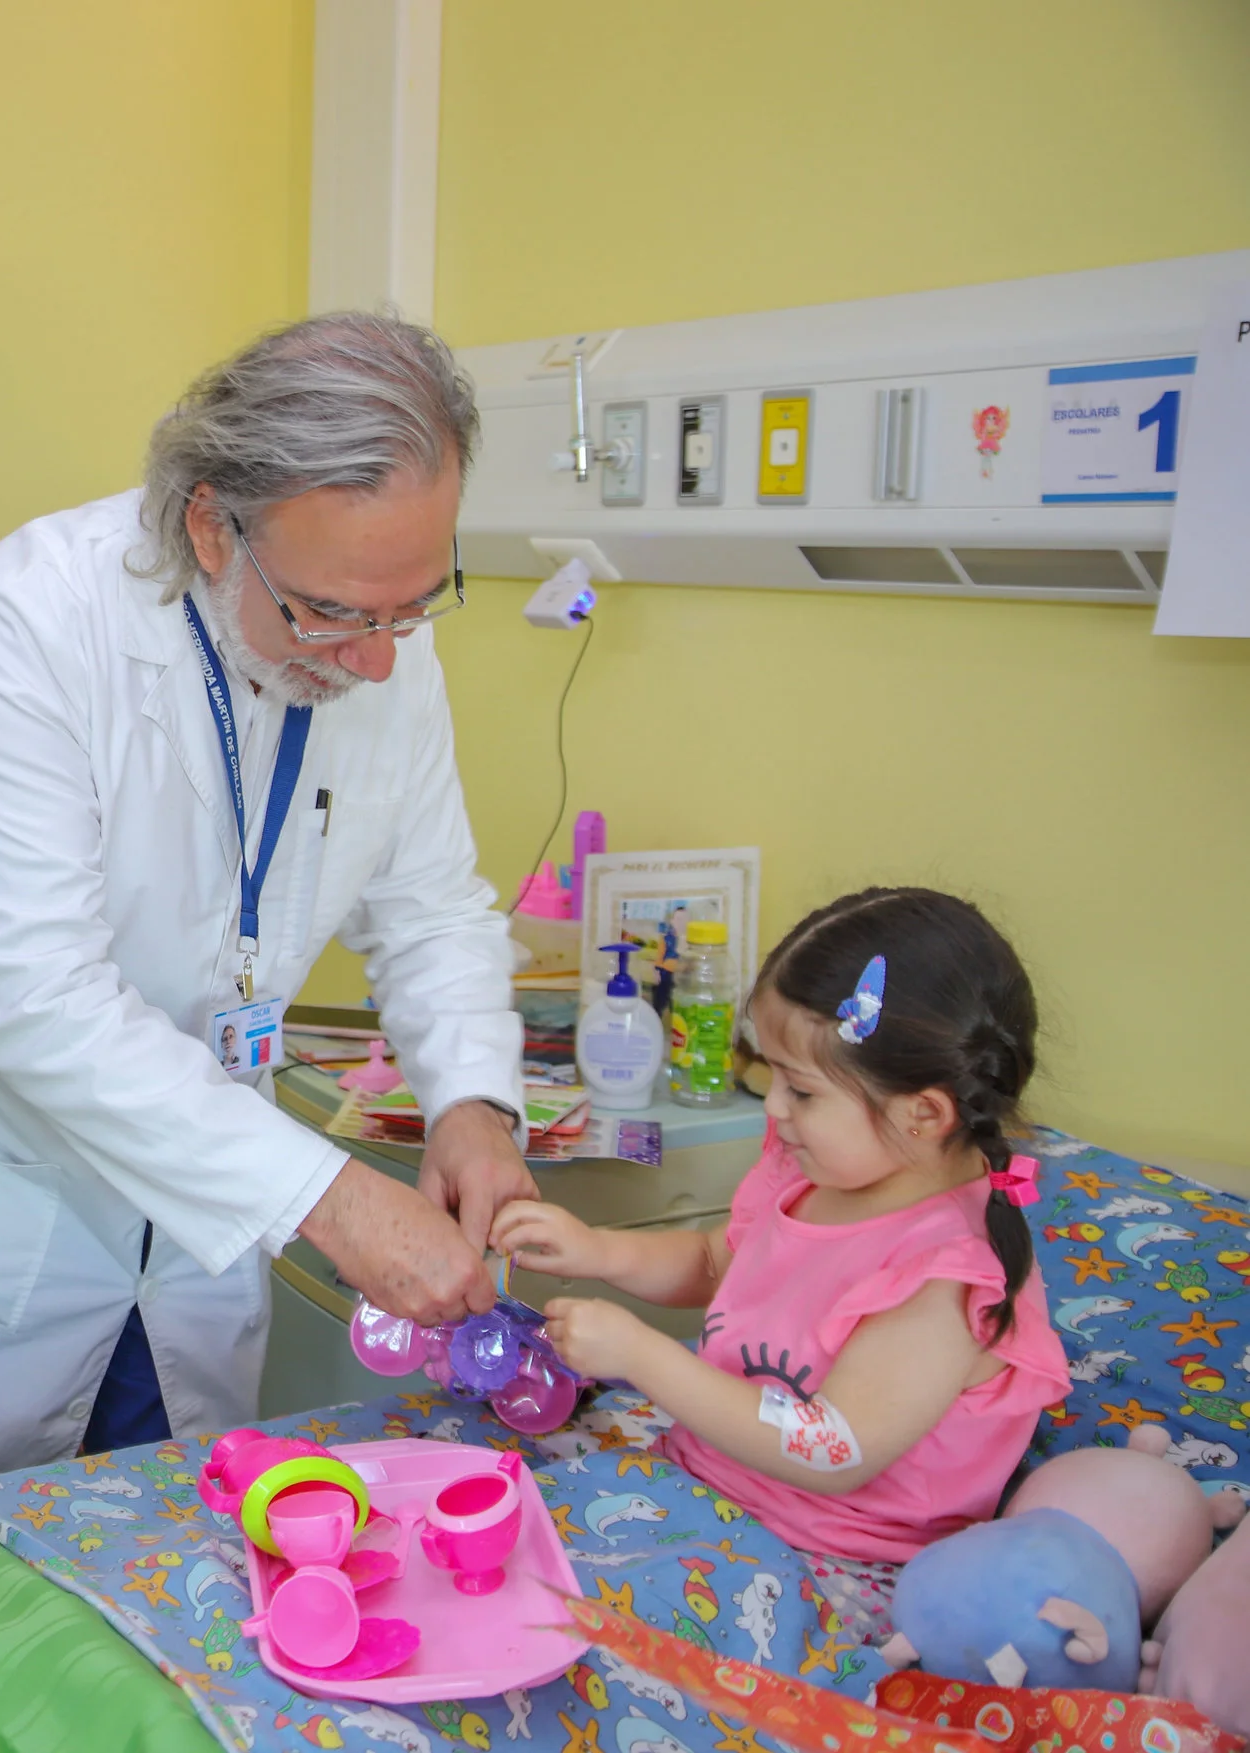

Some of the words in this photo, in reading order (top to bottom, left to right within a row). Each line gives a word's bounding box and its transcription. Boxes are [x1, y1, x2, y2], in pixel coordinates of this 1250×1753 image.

[1053, 406, 1121, 421] ESCOLARES
[1137, 390, 1182, 473] 1
[225, 735, 235, 754] DE
